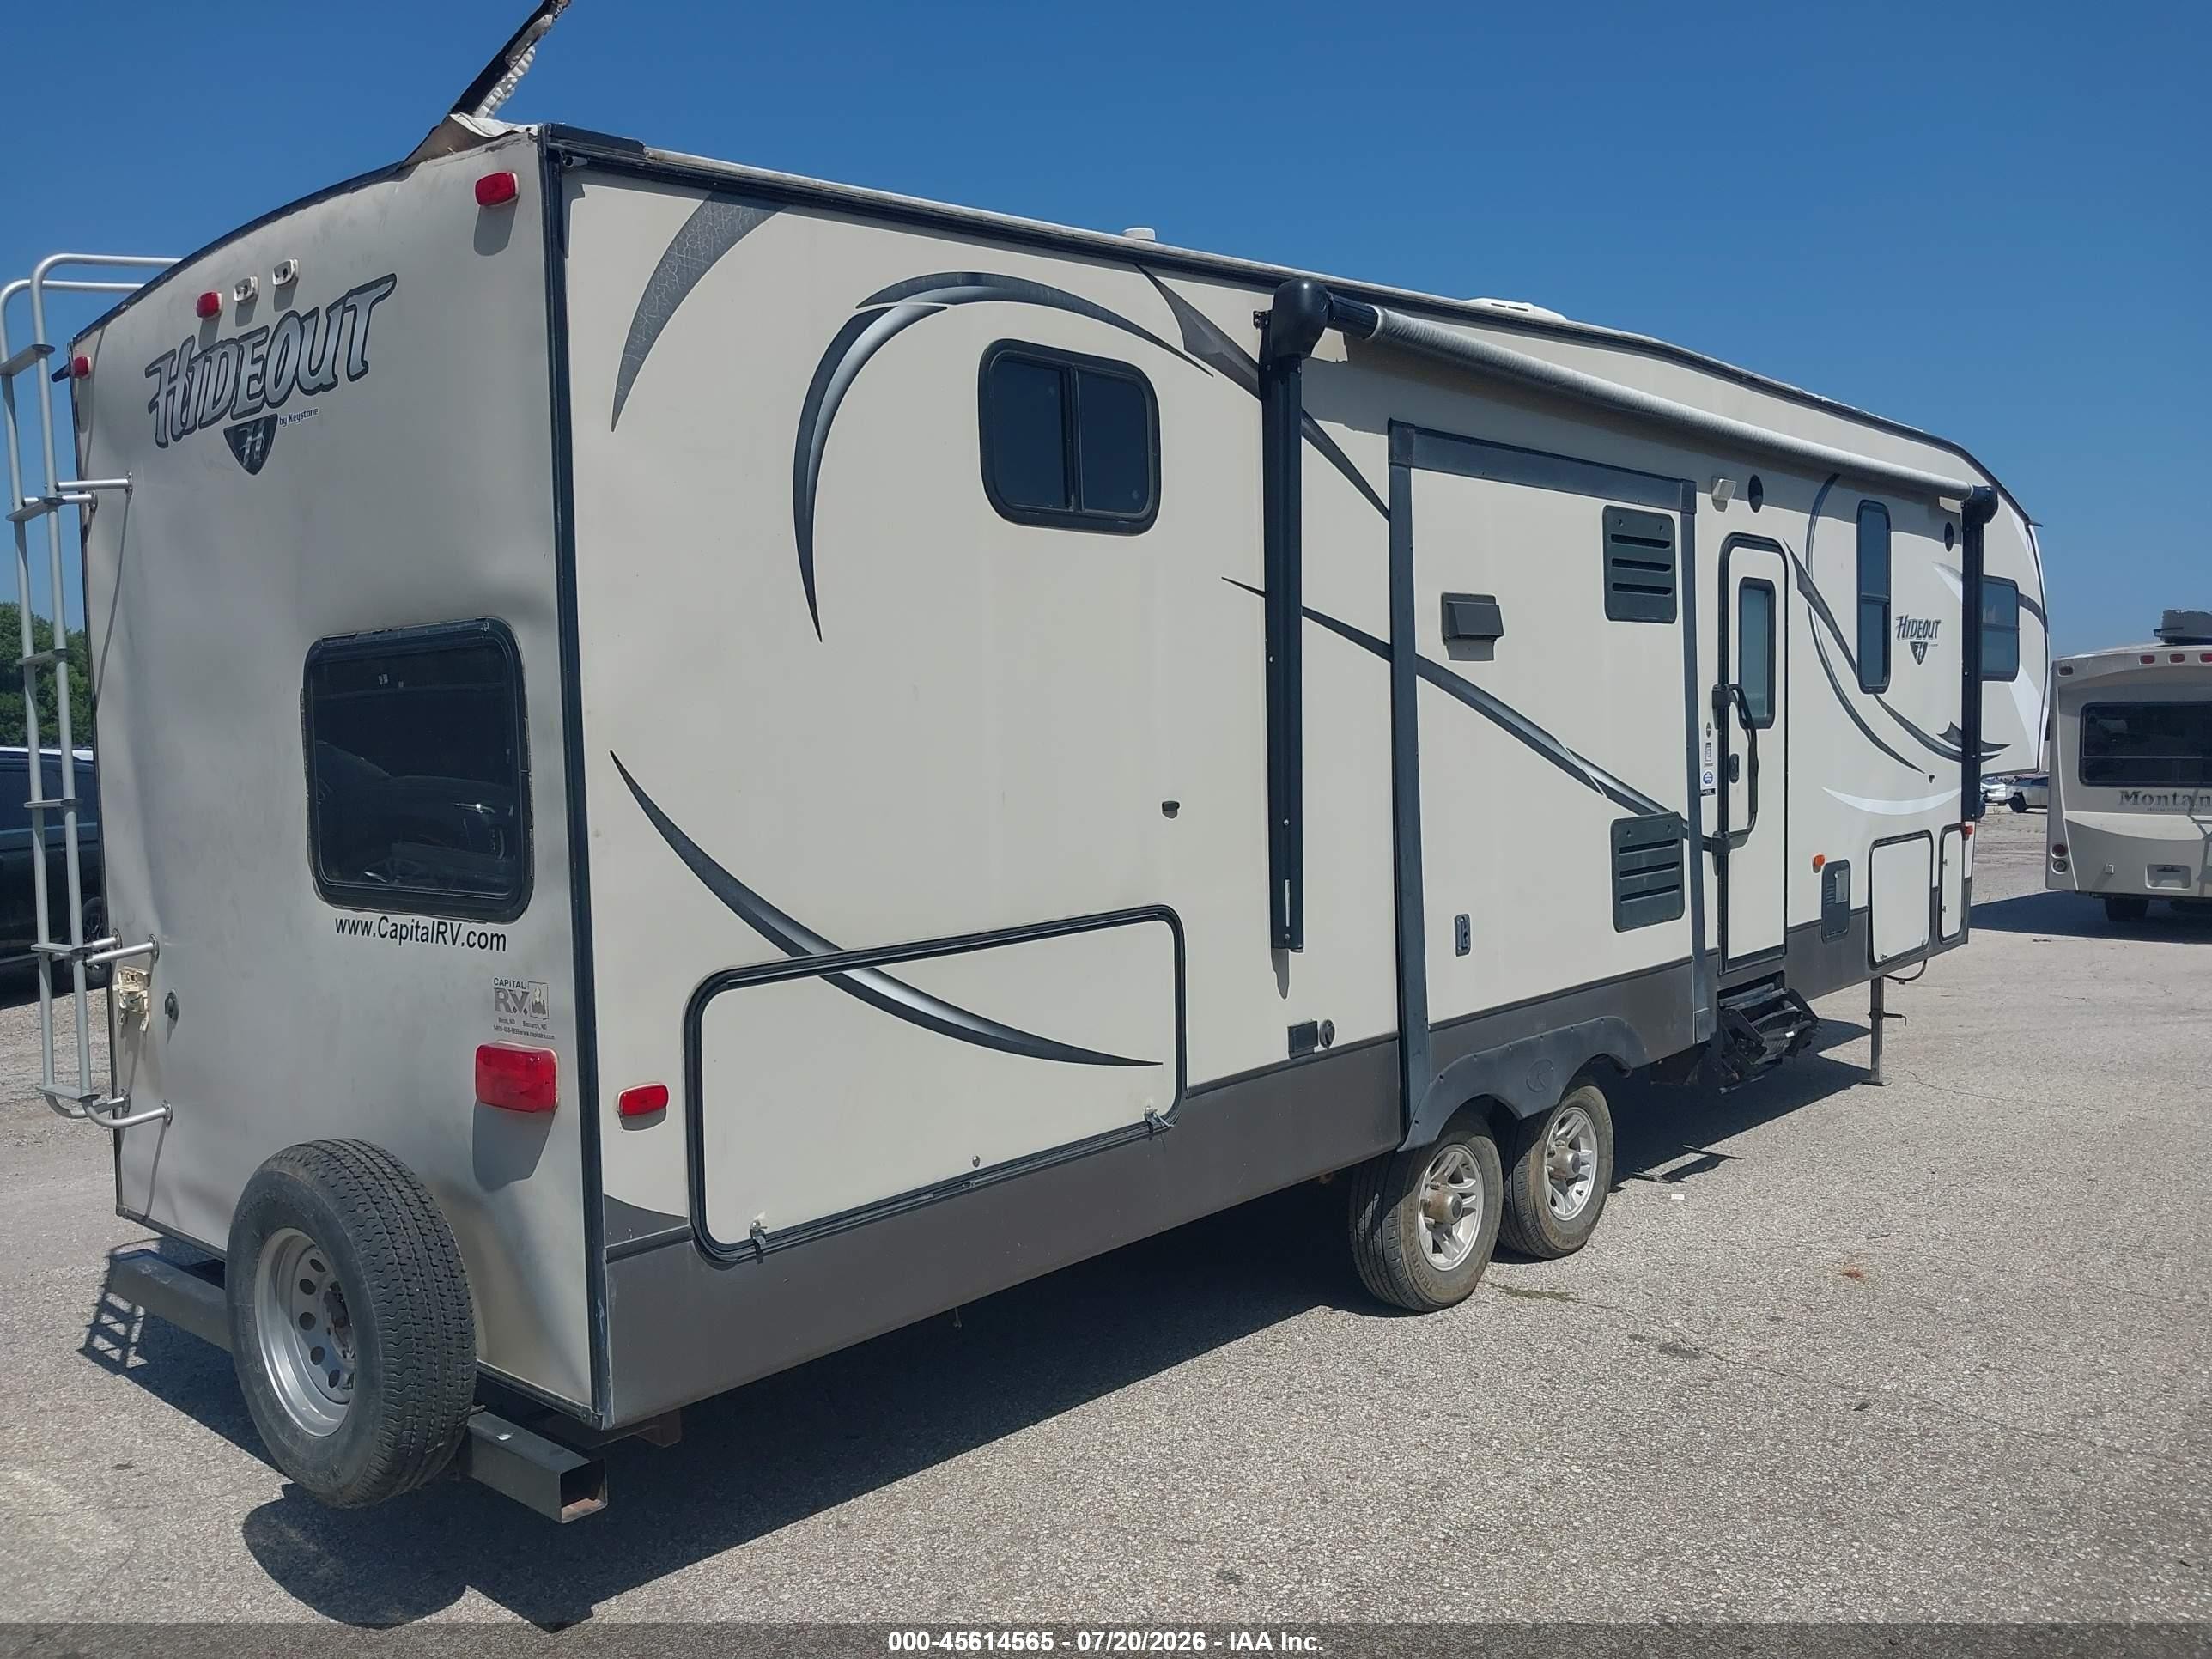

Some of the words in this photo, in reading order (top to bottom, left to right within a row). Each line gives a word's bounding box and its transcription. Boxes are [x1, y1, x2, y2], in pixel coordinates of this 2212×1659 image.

[145, 273, 397, 449] HIDEOUT
[279, 416, 288, 428] by
[289, 408, 319, 423] Keystone
[1896, 614, 1942, 641] HIDEOUT
[335, 915, 507, 952] www.CapitalRV.com
[493, 977, 526, 989] CAPITAL
